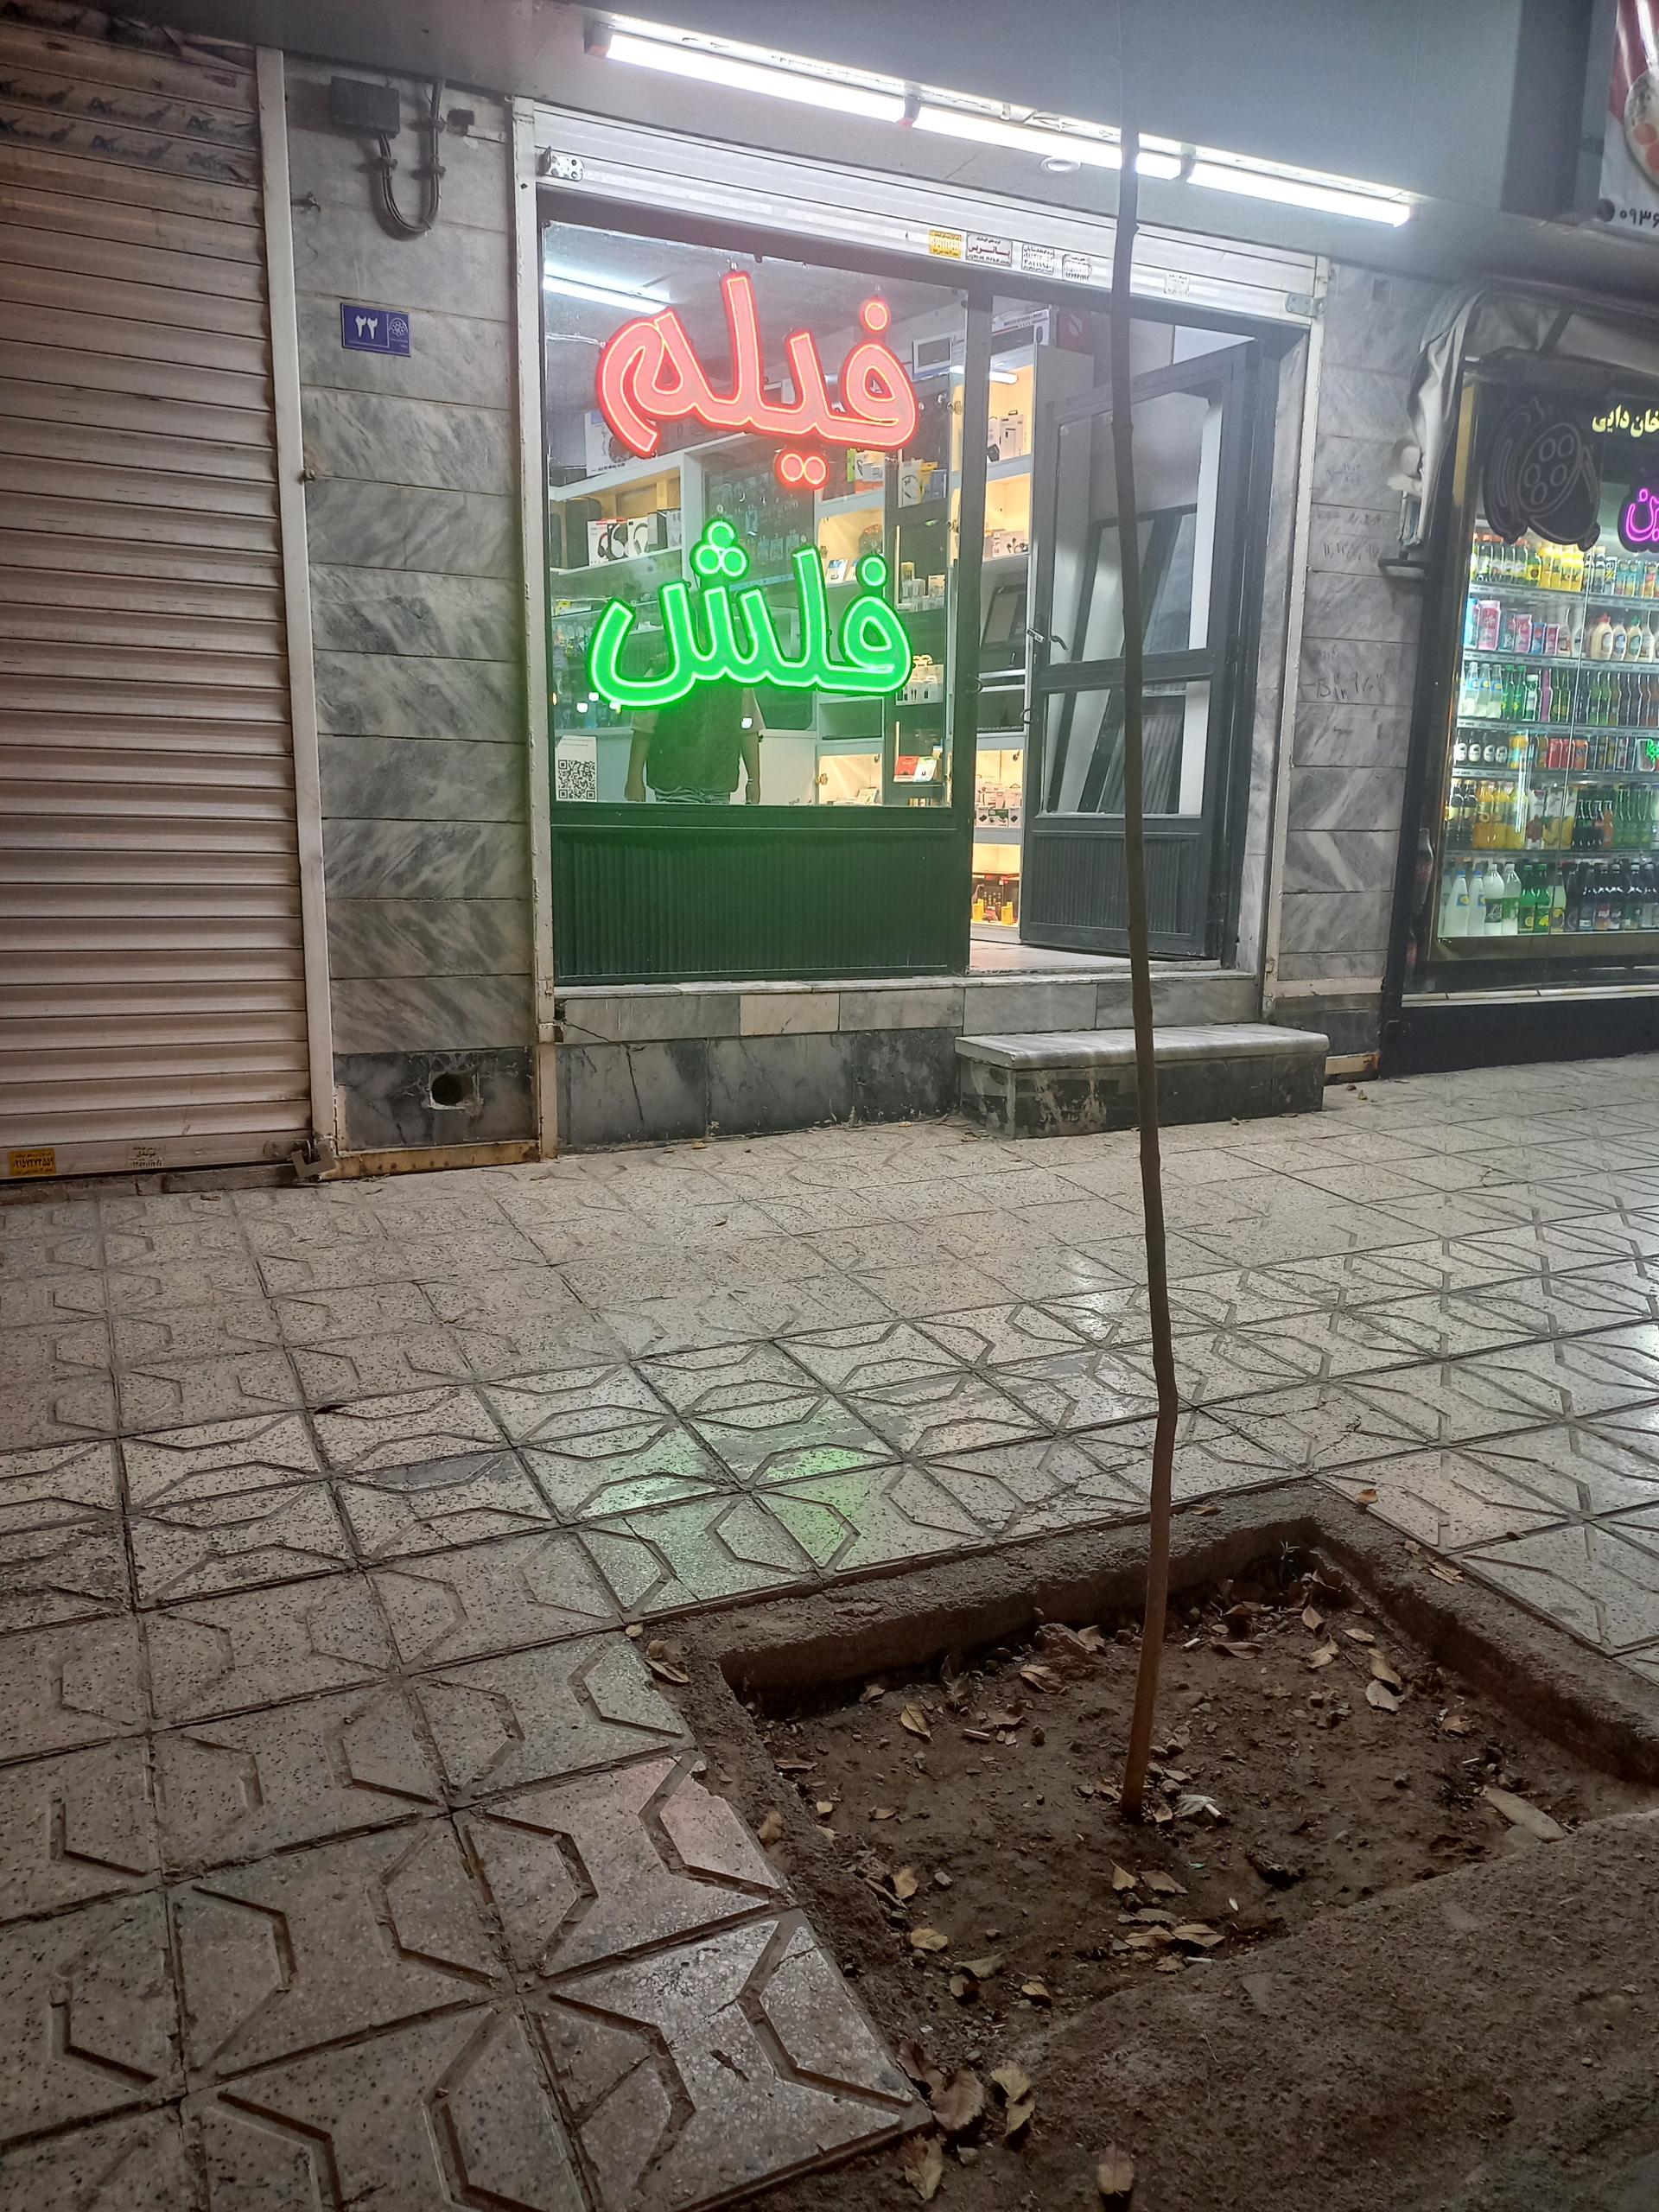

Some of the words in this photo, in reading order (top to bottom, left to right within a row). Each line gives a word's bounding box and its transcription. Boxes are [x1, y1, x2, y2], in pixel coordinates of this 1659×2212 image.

[355, 315, 378, 340] ۲۲
[597, 271, 919, 489] فیلم
[1592, 404, 1630, 433] دایی
[588, 518, 913, 710] فلش
